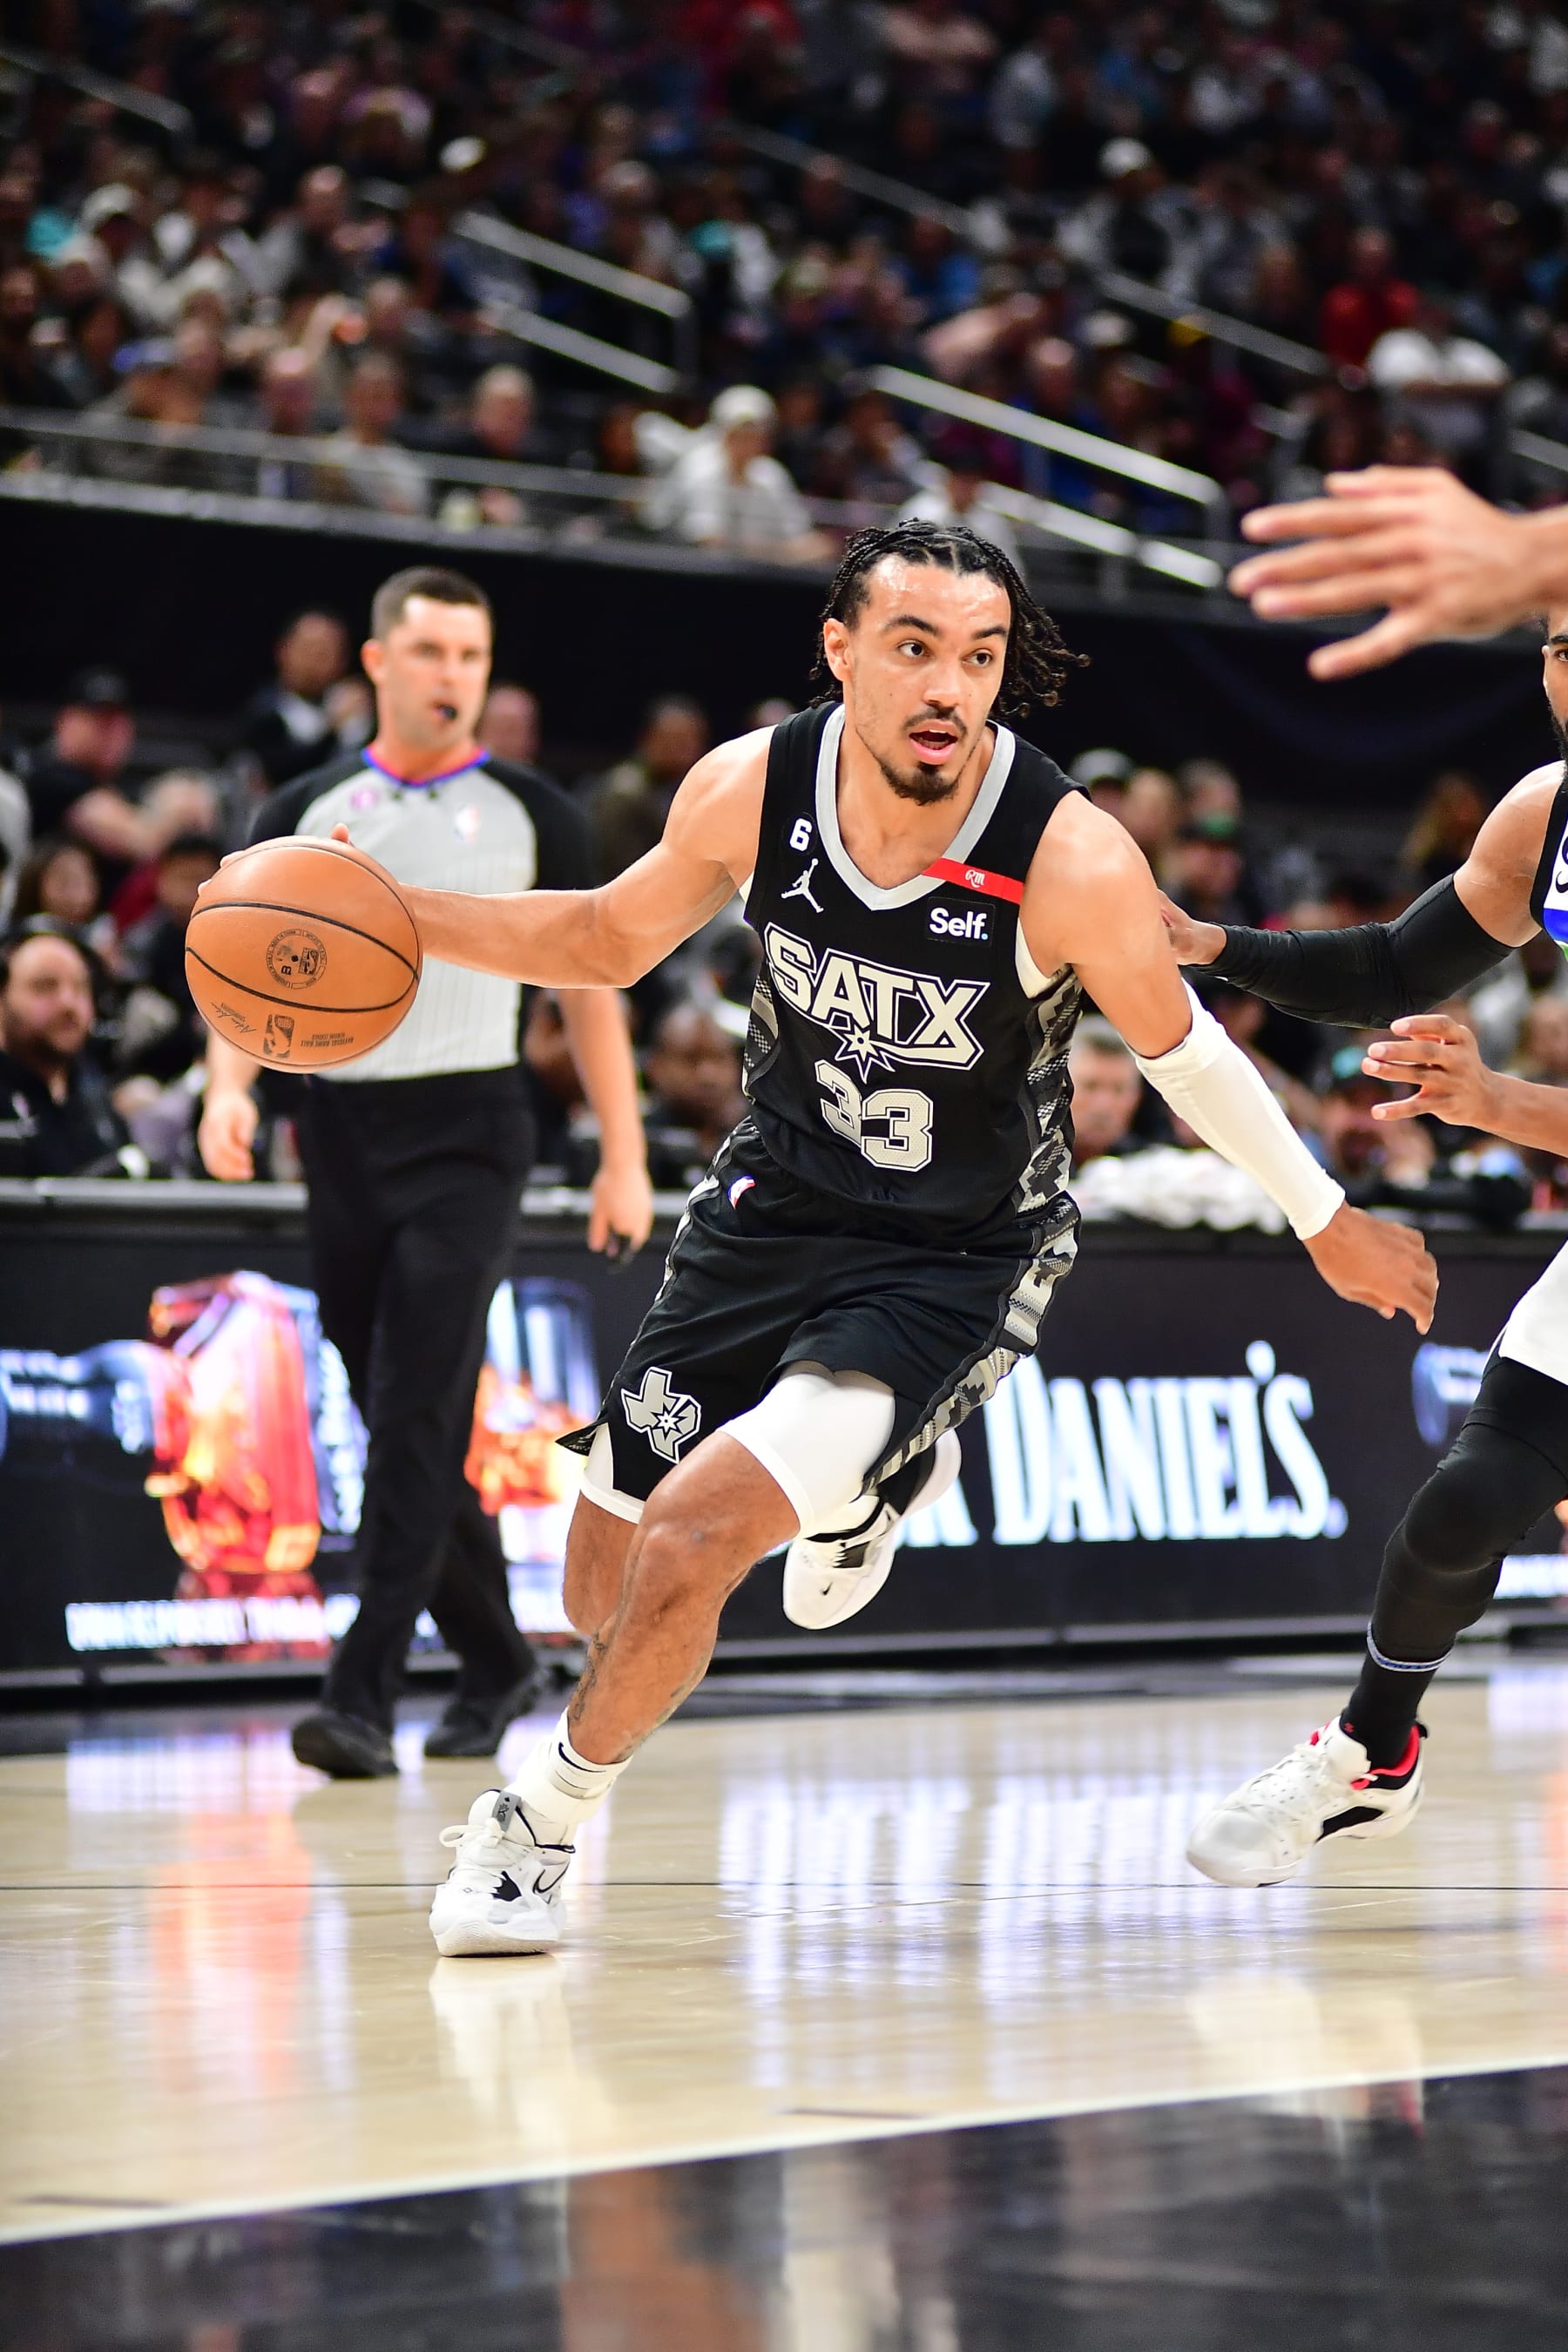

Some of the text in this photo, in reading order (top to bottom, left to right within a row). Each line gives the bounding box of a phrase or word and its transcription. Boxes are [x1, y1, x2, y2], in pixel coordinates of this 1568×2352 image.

[789, 817, 814, 852] 6
[929, 907, 990, 942] Self.
[764, 922, 990, 1070] SATX
[814, 1059, 934, 1173] 33
